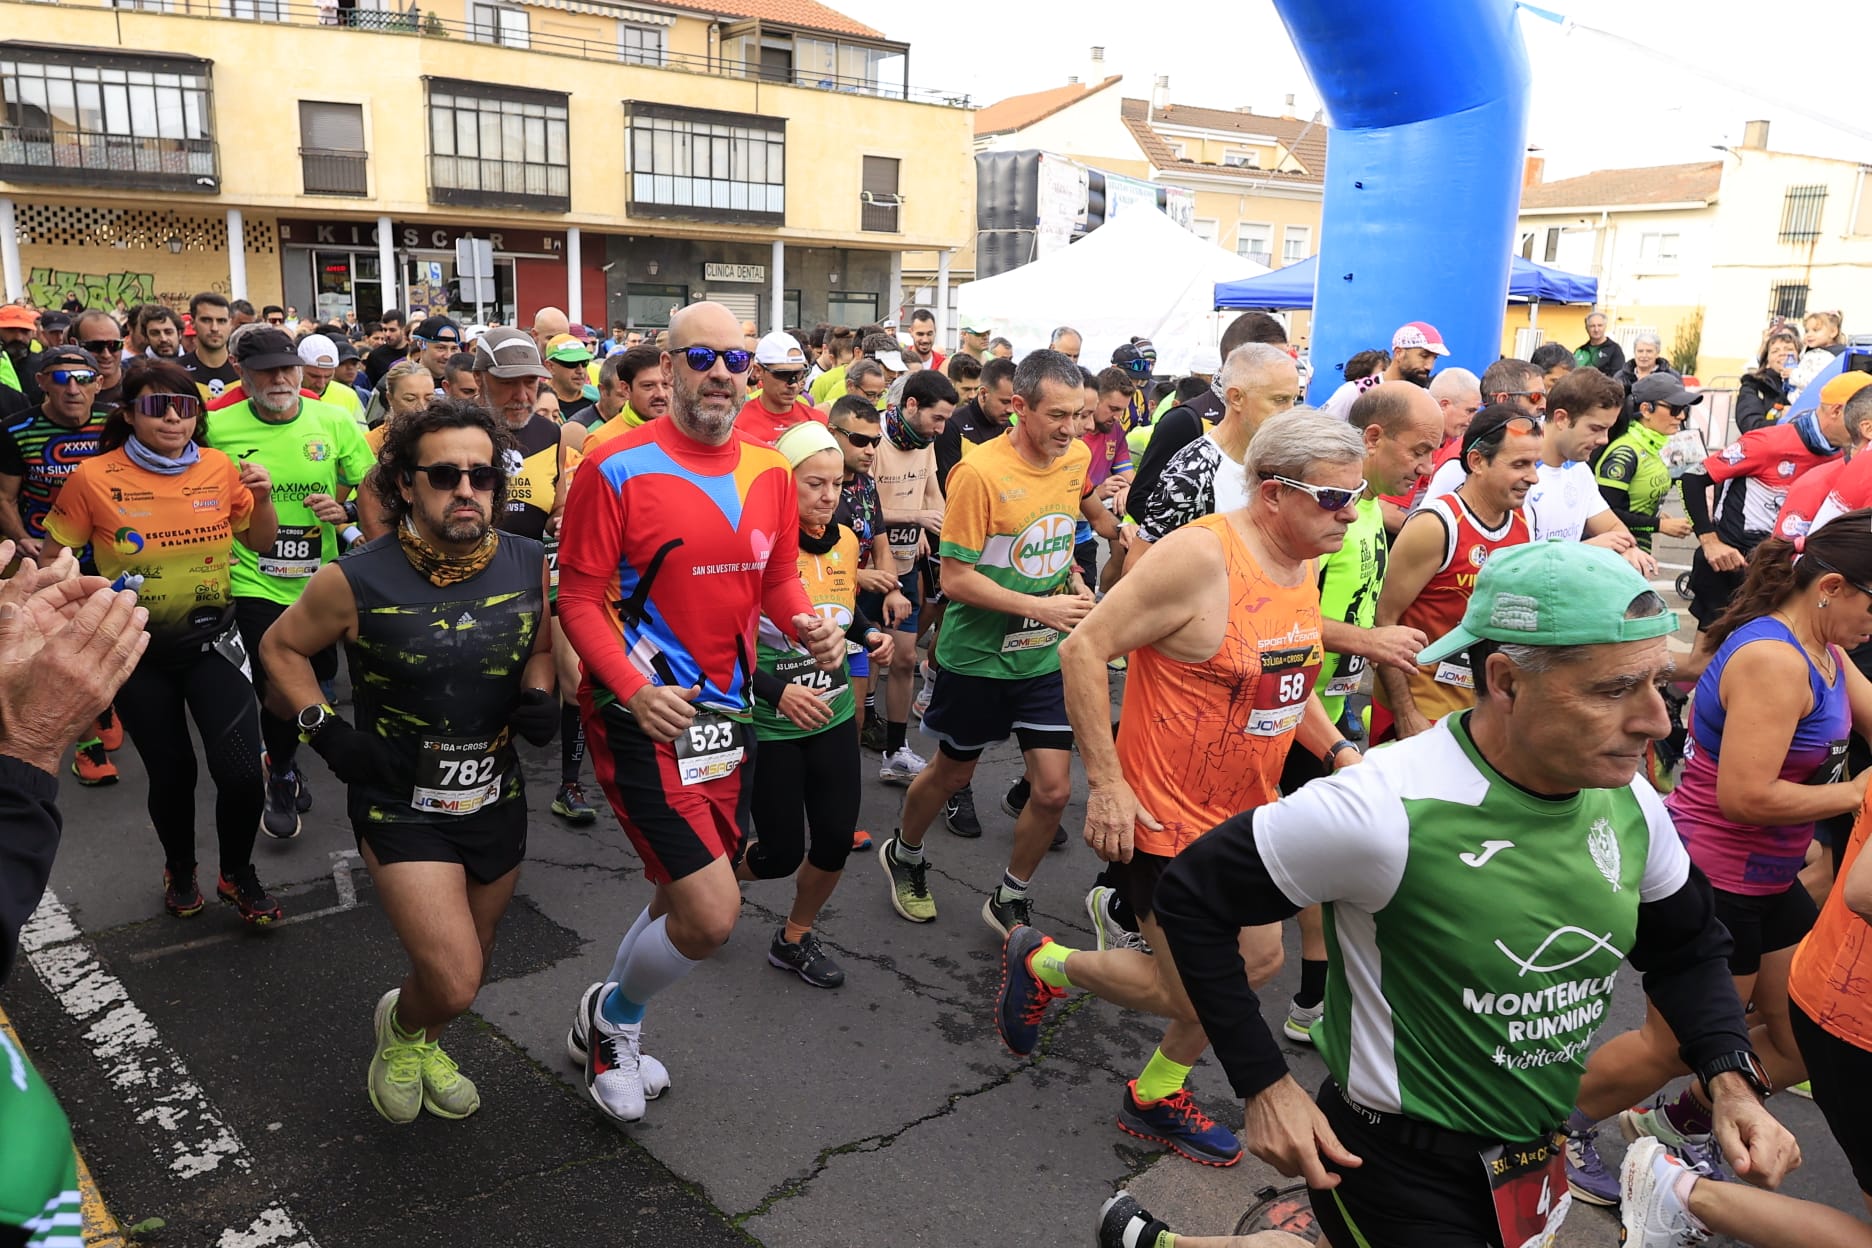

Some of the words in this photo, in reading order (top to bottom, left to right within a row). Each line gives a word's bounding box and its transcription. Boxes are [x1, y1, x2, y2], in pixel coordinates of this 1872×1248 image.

[737, 266, 764, 279] DENTAL
[146, 528, 191, 540] ESCUELA
[889, 528, 917, 544] 540
[274, 540, 310, 558] 188
[261, 564, 318, 576] OMISAG
[692, 566, 706, 576] SAN
[706, 562, 740, 574] SILVESTRE
[1257, 635, 1287, 648] SPORT
[784, 660, 799, 670] LIGA
[1270, 655, 1283, 665] LIGA
[1287, 653, 1304, 664] CROSS
[1279, 672, 1305, 703] 58
[689, 721, 733, 752] 523
[438, 743, 455, 752] IGA
[462, 741, 489, 752] CROSS
[439, 756, 496, 786] 782
[1508, 998, 1604, 1043] RUNNING
[1491, 1159, 1504, 1176] 33
